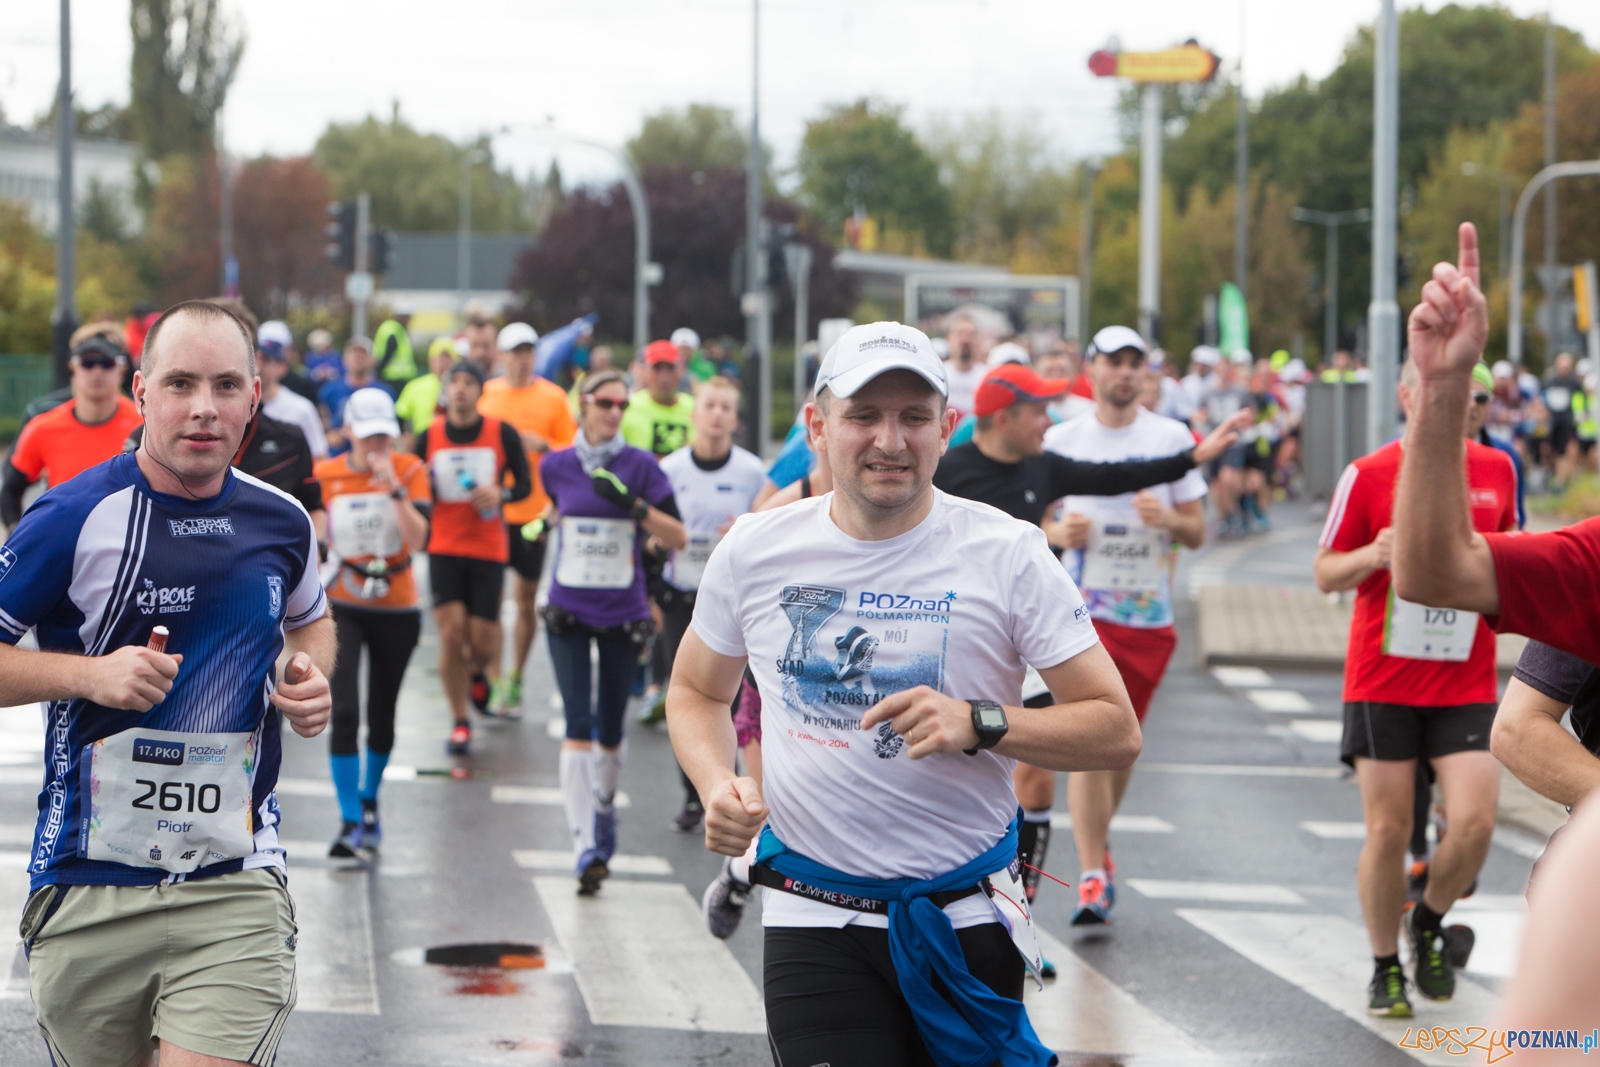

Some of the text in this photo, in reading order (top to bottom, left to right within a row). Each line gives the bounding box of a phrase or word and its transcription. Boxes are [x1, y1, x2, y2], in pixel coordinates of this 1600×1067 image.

[169, 518, 230, 528] EXTREME
[140, 604, 191, 615] W BIEGU
[856, 610, 950, 624] PÓŁMARATON
[884, 627, 909, 644] MÓJ
[828, 739, 850, 749] 2014
[138, 745, 180, 759] 17. PKO
[187, 754, 226, 763] maraton
[132, 779, 221, 813] 2610
[157, 820, 193, 833] Piotr
